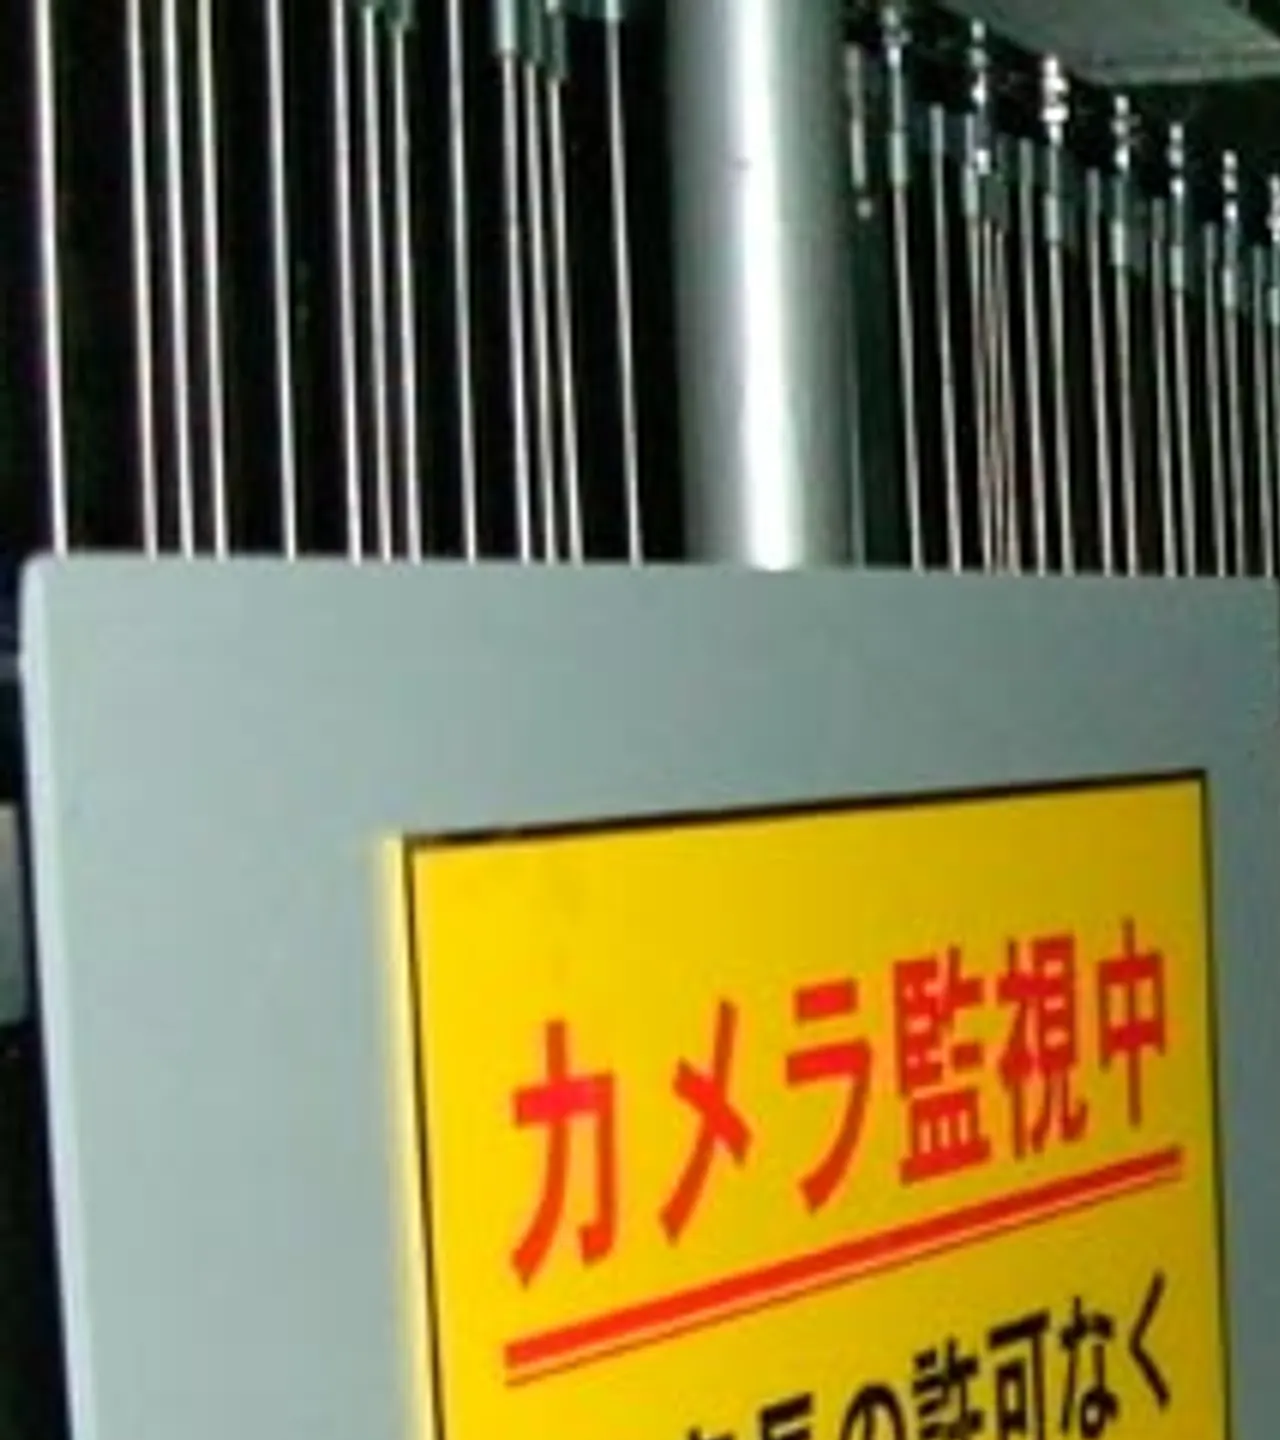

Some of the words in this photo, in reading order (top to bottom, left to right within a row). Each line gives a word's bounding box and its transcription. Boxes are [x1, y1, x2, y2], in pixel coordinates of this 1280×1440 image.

[509, 916, 1169, 1290] カメラ監視中
